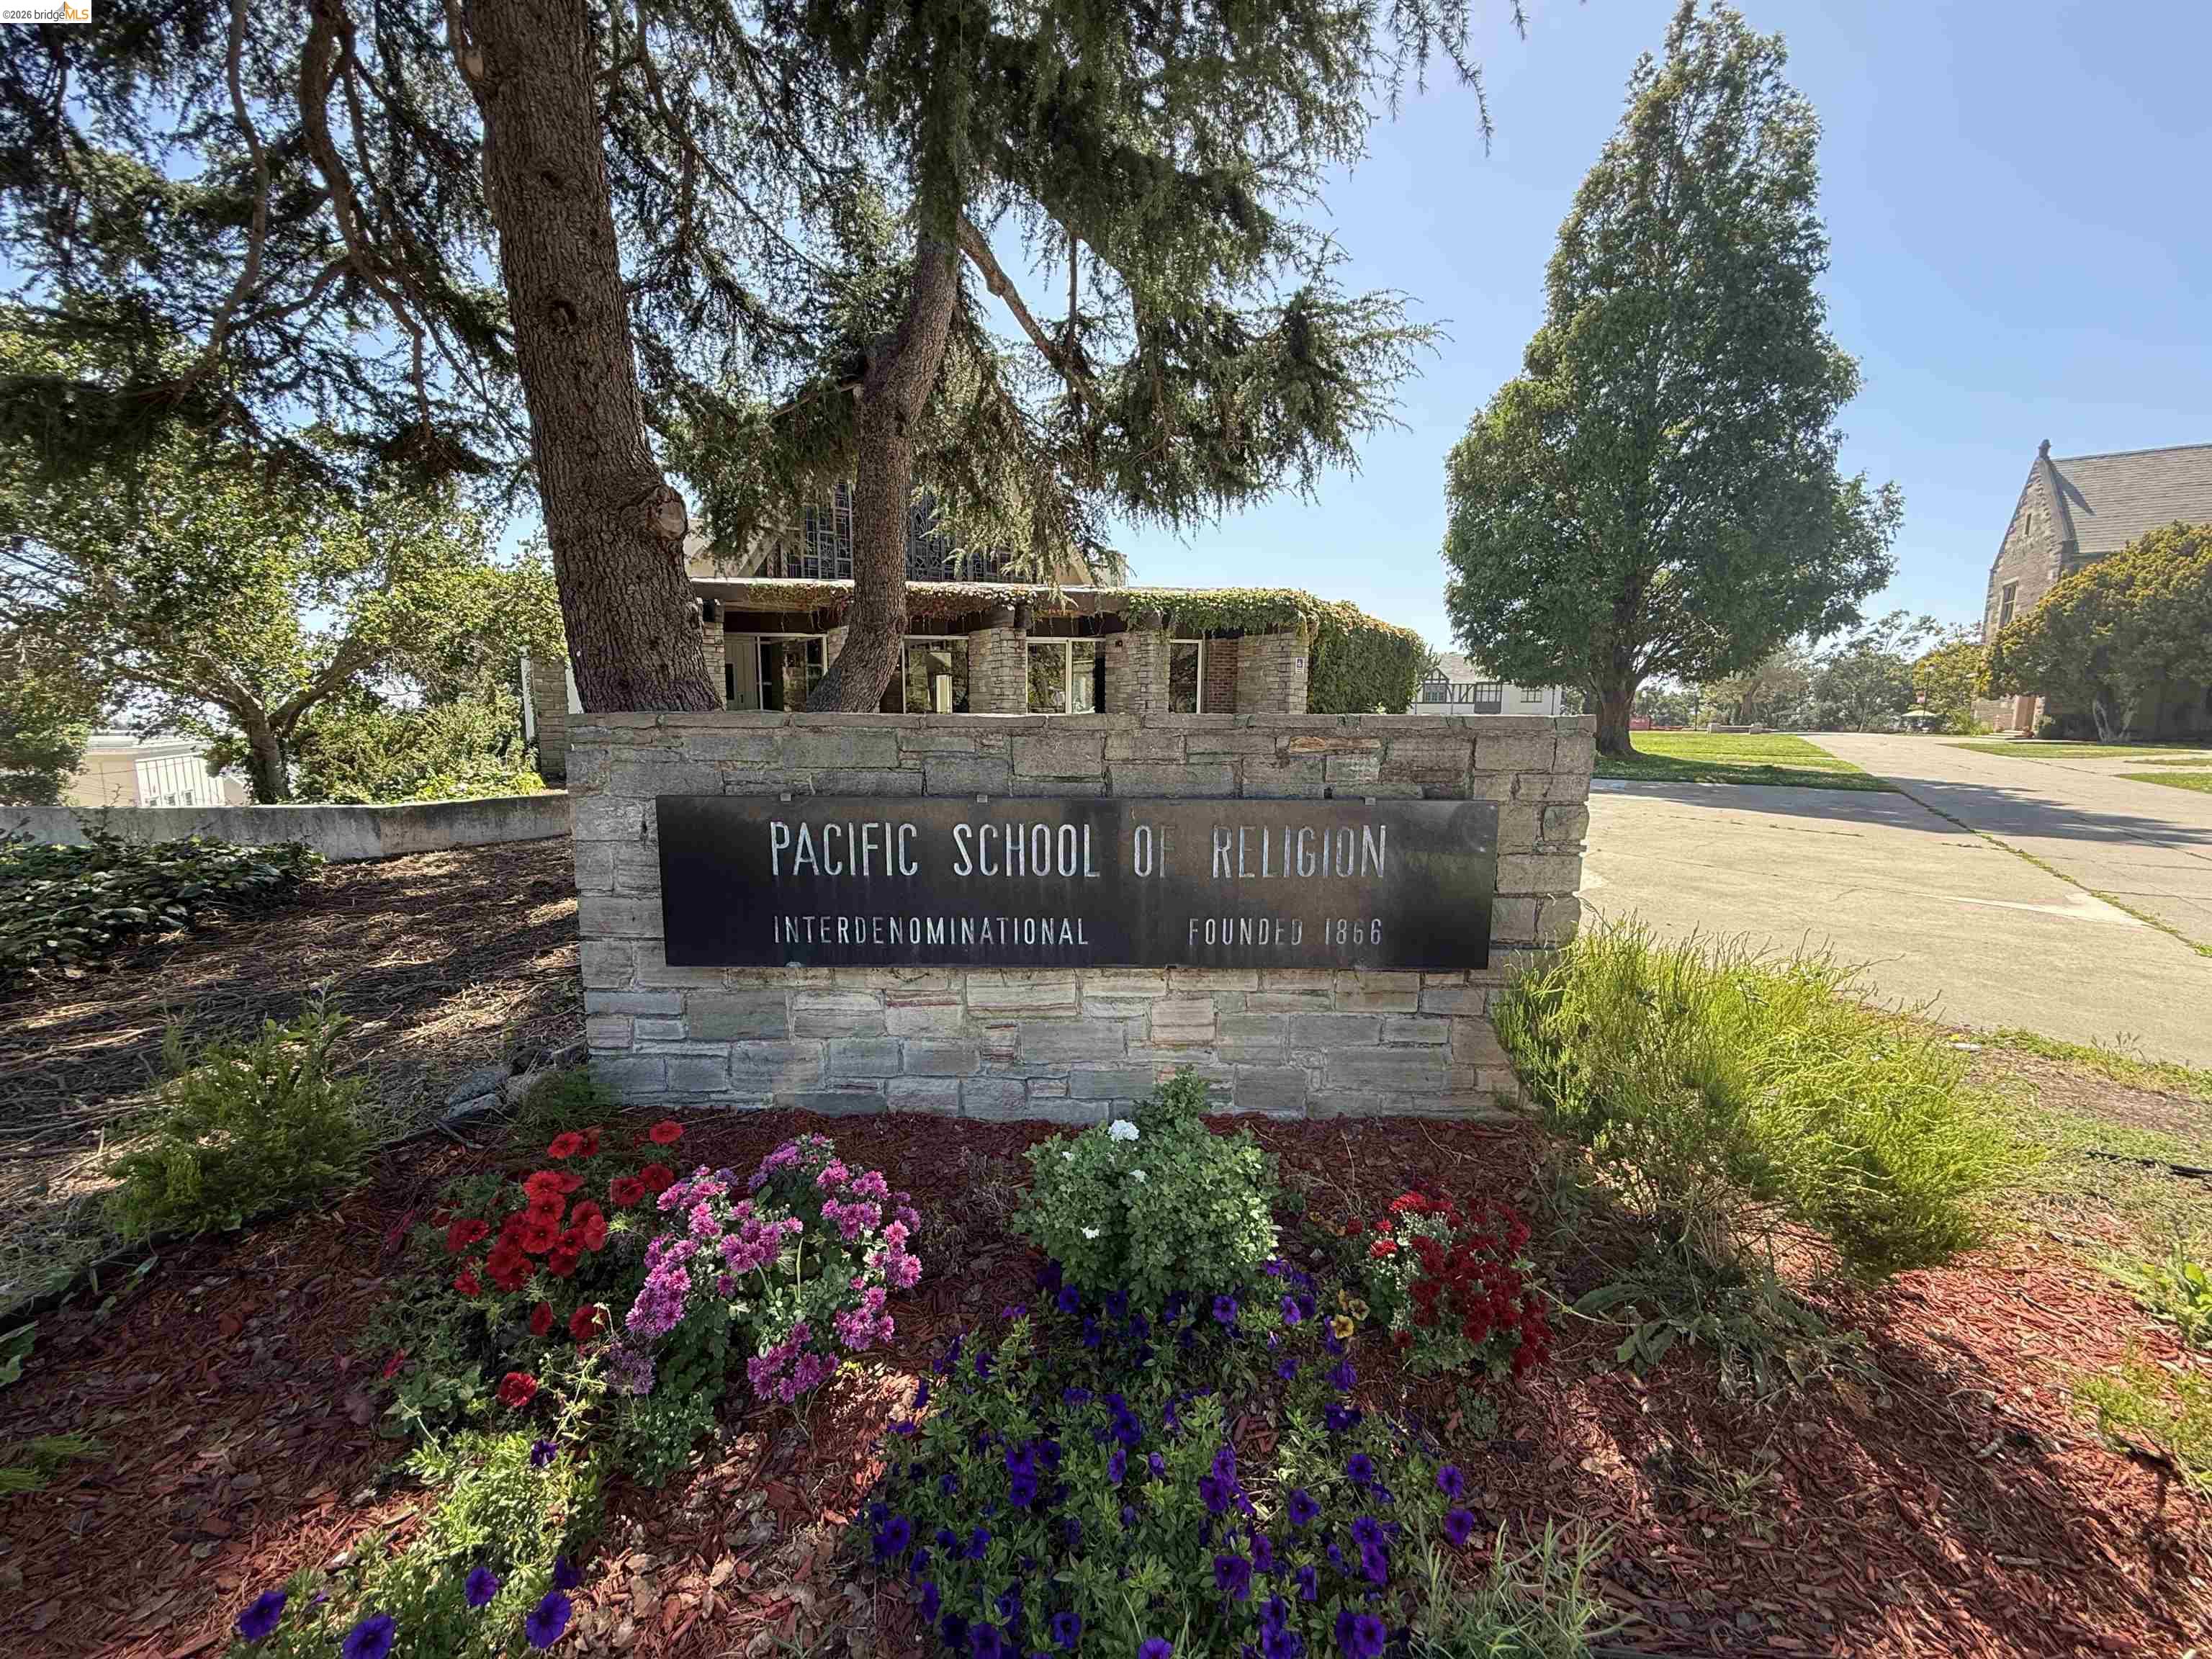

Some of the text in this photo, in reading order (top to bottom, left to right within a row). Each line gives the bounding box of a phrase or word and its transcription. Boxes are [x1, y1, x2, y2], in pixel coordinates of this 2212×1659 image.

[770, 821, 1387, 878] PACIFIC SCHOOL OF RELIGION
[773, 916, 1089, 945] INTERDENOMINATIONAL
[1189, 918, 1382, 945] FOUNDED 1866
